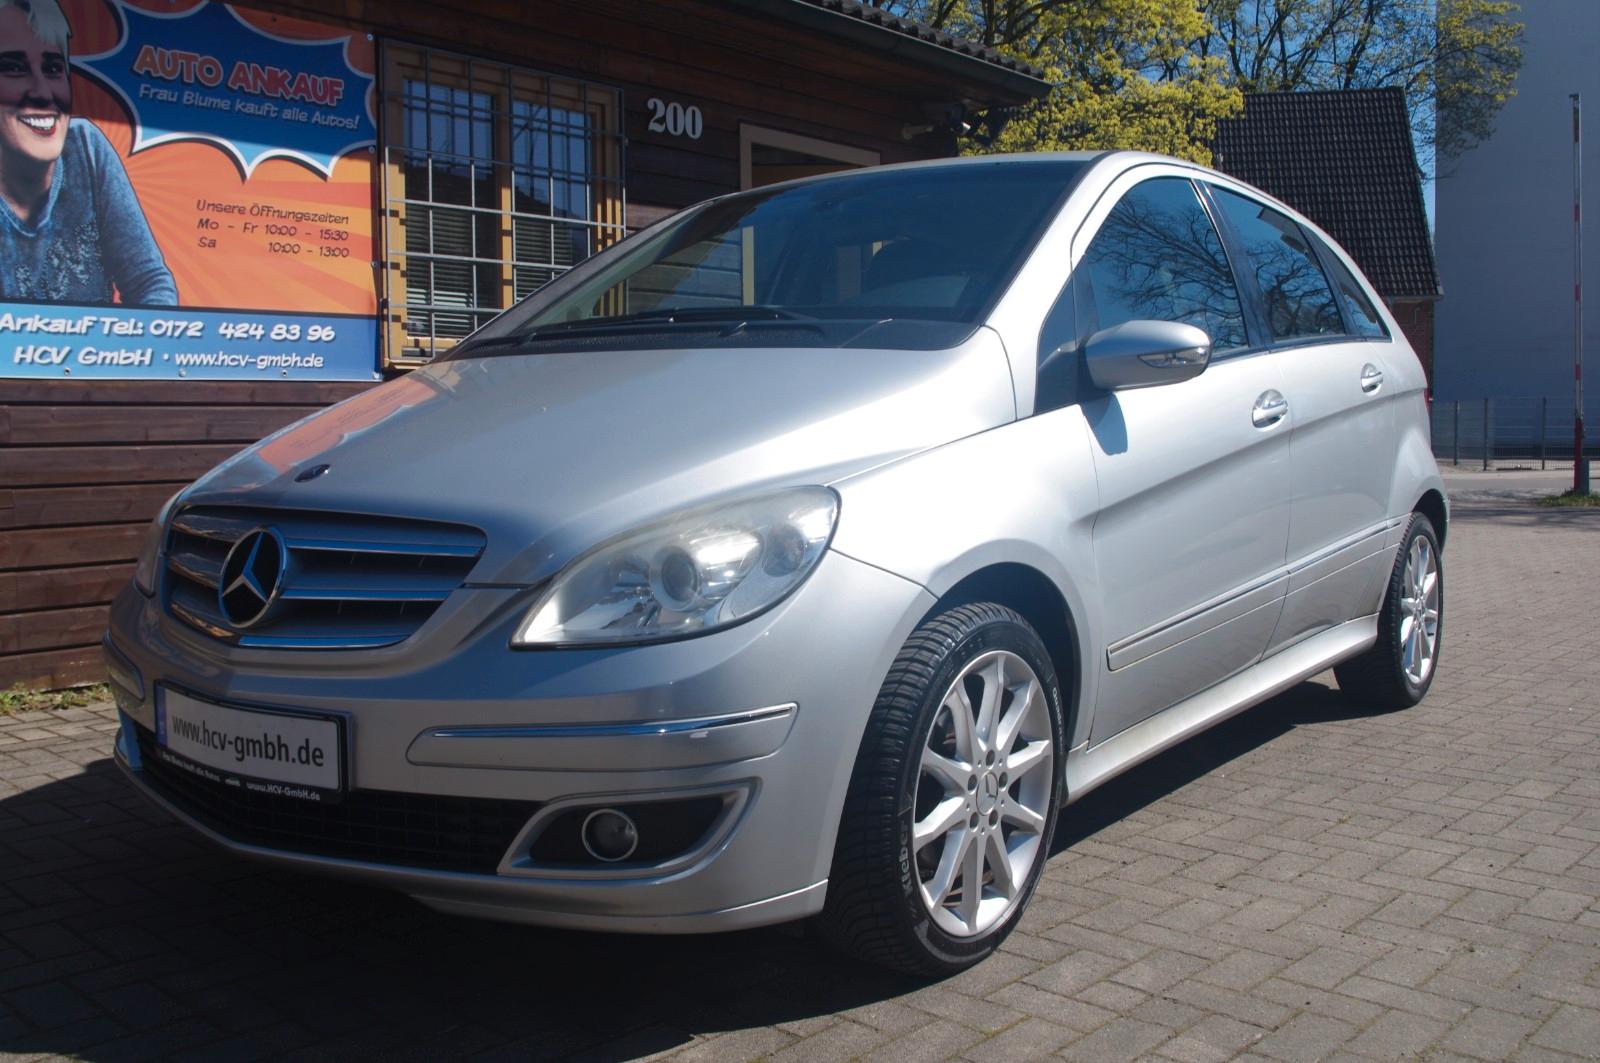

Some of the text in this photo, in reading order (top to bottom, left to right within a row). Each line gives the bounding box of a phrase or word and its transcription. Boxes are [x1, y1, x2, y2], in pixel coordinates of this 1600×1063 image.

[132, 45, 345, 106] AUTO ANKAUF
[140, 83, 361, 130] Frau Blume kauft alle Autos!
[647, 98, 703, 139] 200
[196, 199, 350, 225] Unsere Öffnungszeiten
[197, 218, 219, 231] Mo
[242, 222, 259, 234] Fr
[265, 224, 298, 237] 10:00
[319, 228, 350, 241] 15:30
[198, 236, 217, 249] Sa
[268, 242, 301, 255] 10:00
[319, 246, 350, 258] 13:00
[0, 313, 98, 334] Ankauf
[149, 319, 205, 337] 0172
[218, 322, 265, 340] 424
[270, 324, 301, 341] 83
[306, 325, 336, 342] 96
[13, 345, 325, 370] HCV GmbH www.hcv-gmbh.de
[171, 715, 325, 768] www.hcv-gmbh.de
